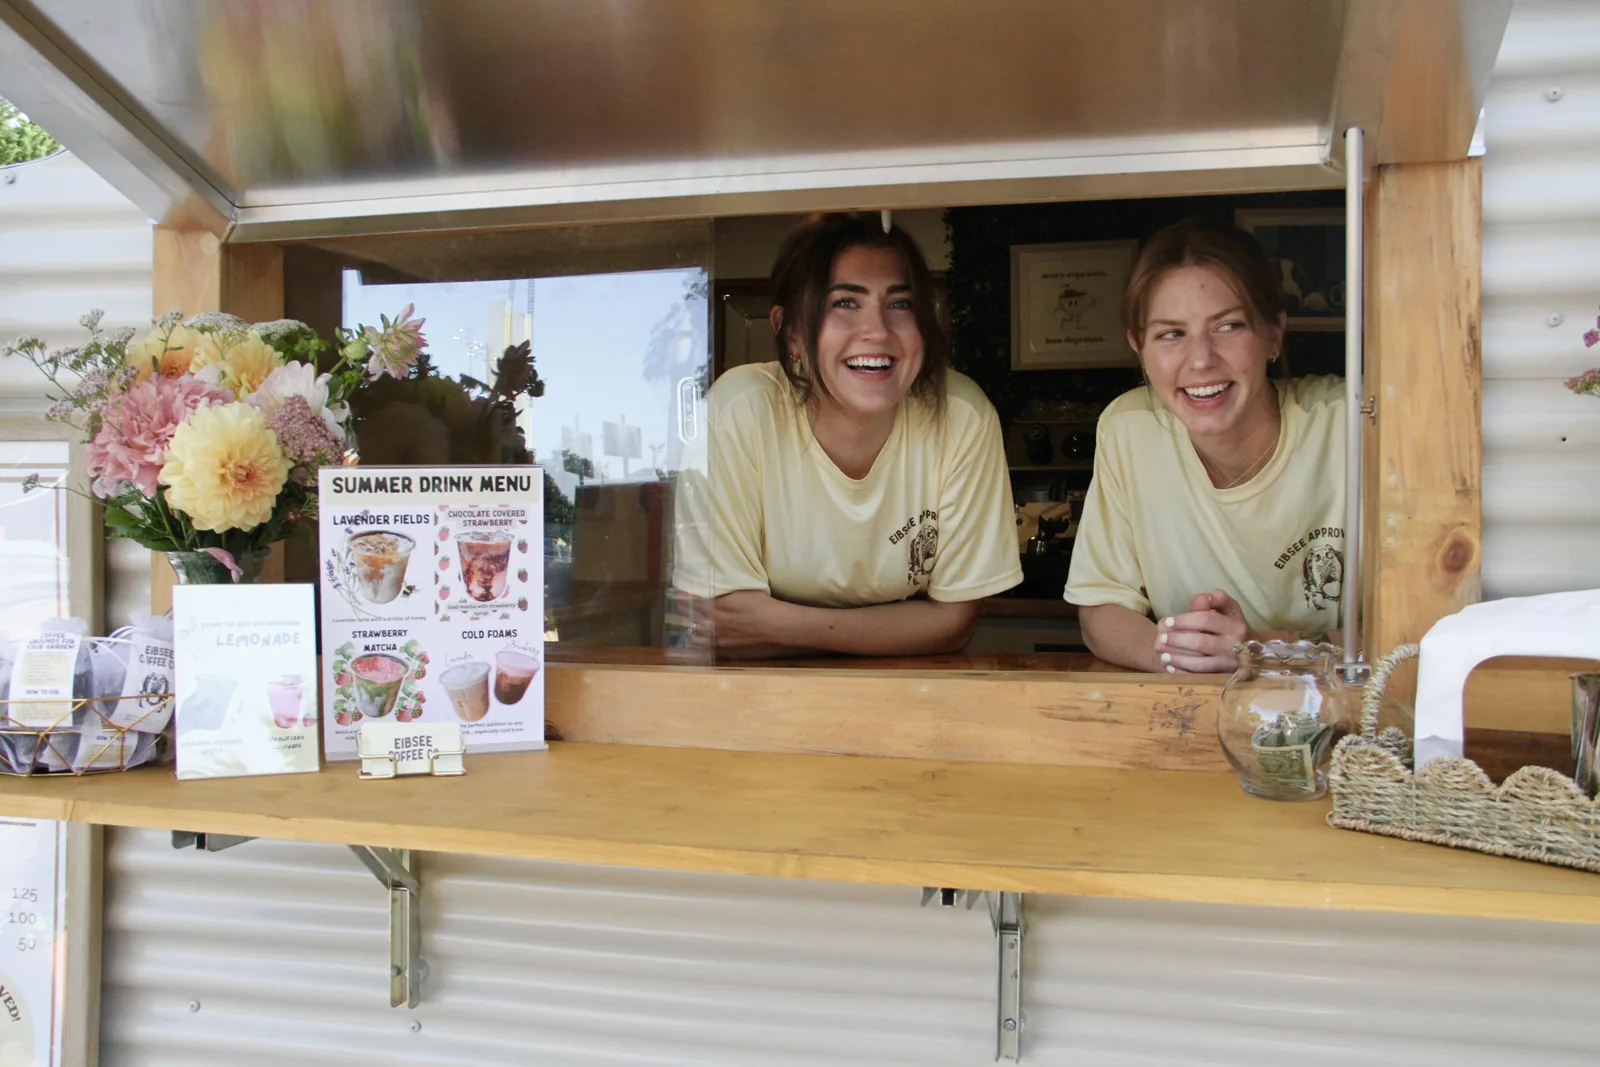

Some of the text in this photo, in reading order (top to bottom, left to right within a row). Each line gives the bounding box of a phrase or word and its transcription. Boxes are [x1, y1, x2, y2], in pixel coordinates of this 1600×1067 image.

[332, 475, 531, 494] SUMMER DRINK MENU
[333, 513, 430, 526] LAVENDER FIELDS
[448, 509, 525, 518] CHOCOLATE COVERED
[463, 519, 513, 527] STRAWBERRY
[888, 517, 916, 545] EIBSEE
[1273, 538, 1307, 570] EIBSEE
[216, 632, 301, 647] LEMONADE
[351, 629, 408, 639] STRAWBERRY
[461, 629, 517, 640] COLD FOAMS
[145, 644, 174, 660] EIBSEE
[363, 643, 397, 652] MATCHA
[394, 735, 433, 750] EIBSEE
[12, 887, 38, 903] 1.25
[9, 912, 38, 925] 1.00
[16, 937, 36, 952] .50
